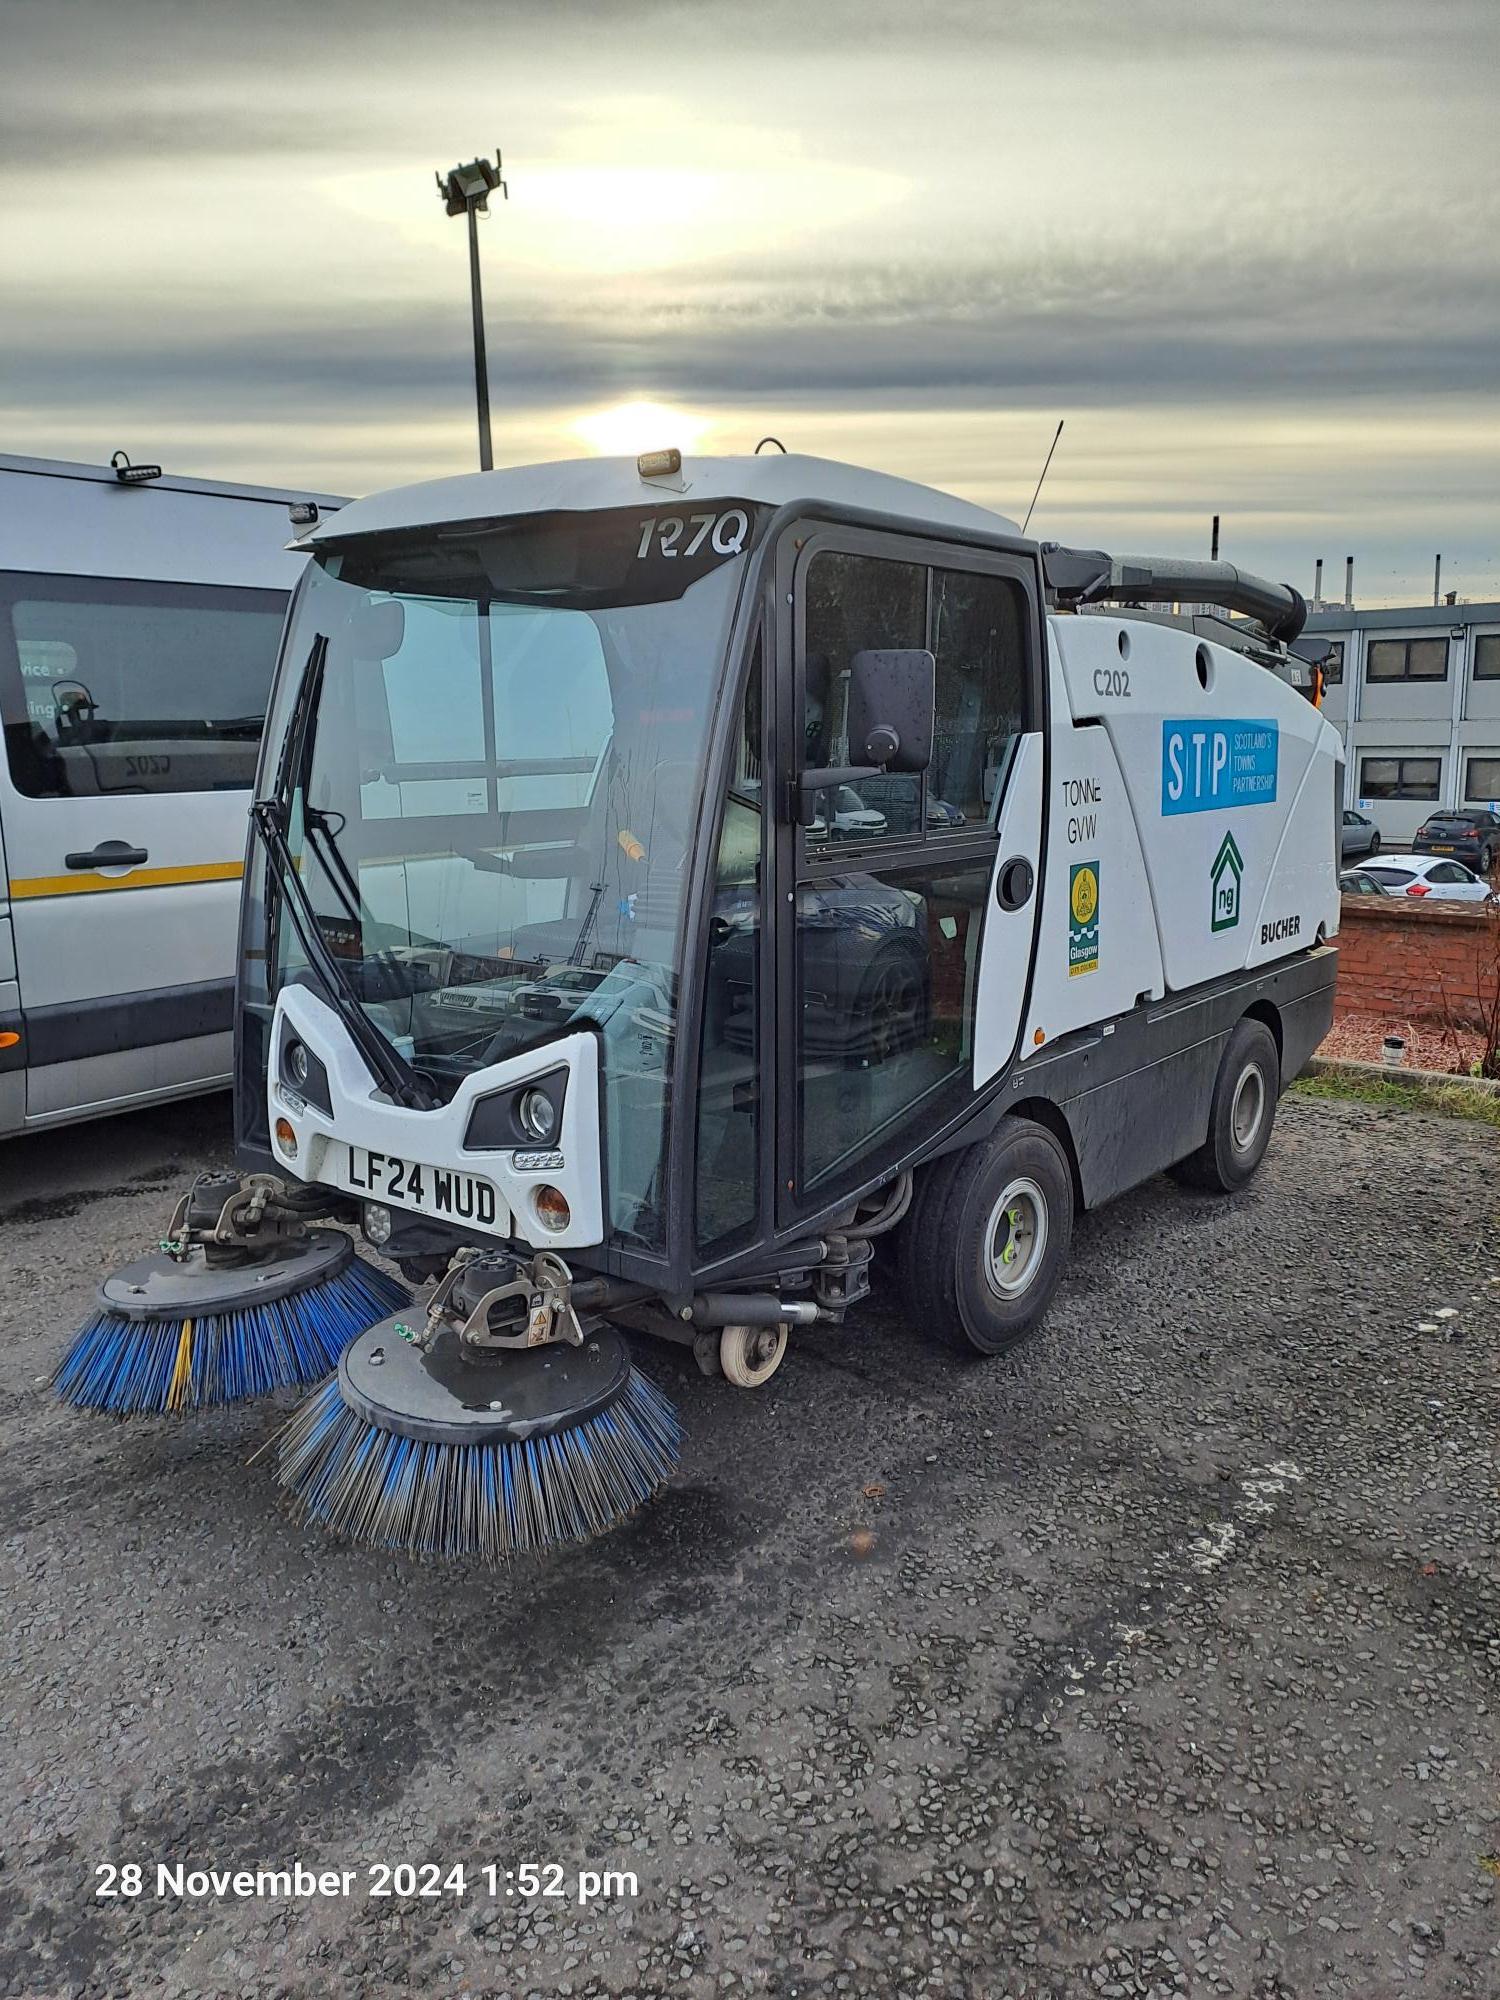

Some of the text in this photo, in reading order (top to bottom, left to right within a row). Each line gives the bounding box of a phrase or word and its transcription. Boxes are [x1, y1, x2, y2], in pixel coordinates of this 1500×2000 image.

[637, 508, 748, 558] 127Q
[1093, 668, 1132, 697] C202
[1233, 732, 1272, 751] SCOTLAND'S
[1233, 754, 1256, 772] TOWNS
[1232, 774, 1275, 793] PARTNERSHIP
[1068, 814, 1097, 844] GVW
[1219, 887, 1234, 915] ng
[1261, 915, 1301, 945] BUCHER
[1070, 944, 1098, 960] Glasgow
[349, 1146, 495, 1225] LF24 WUD
